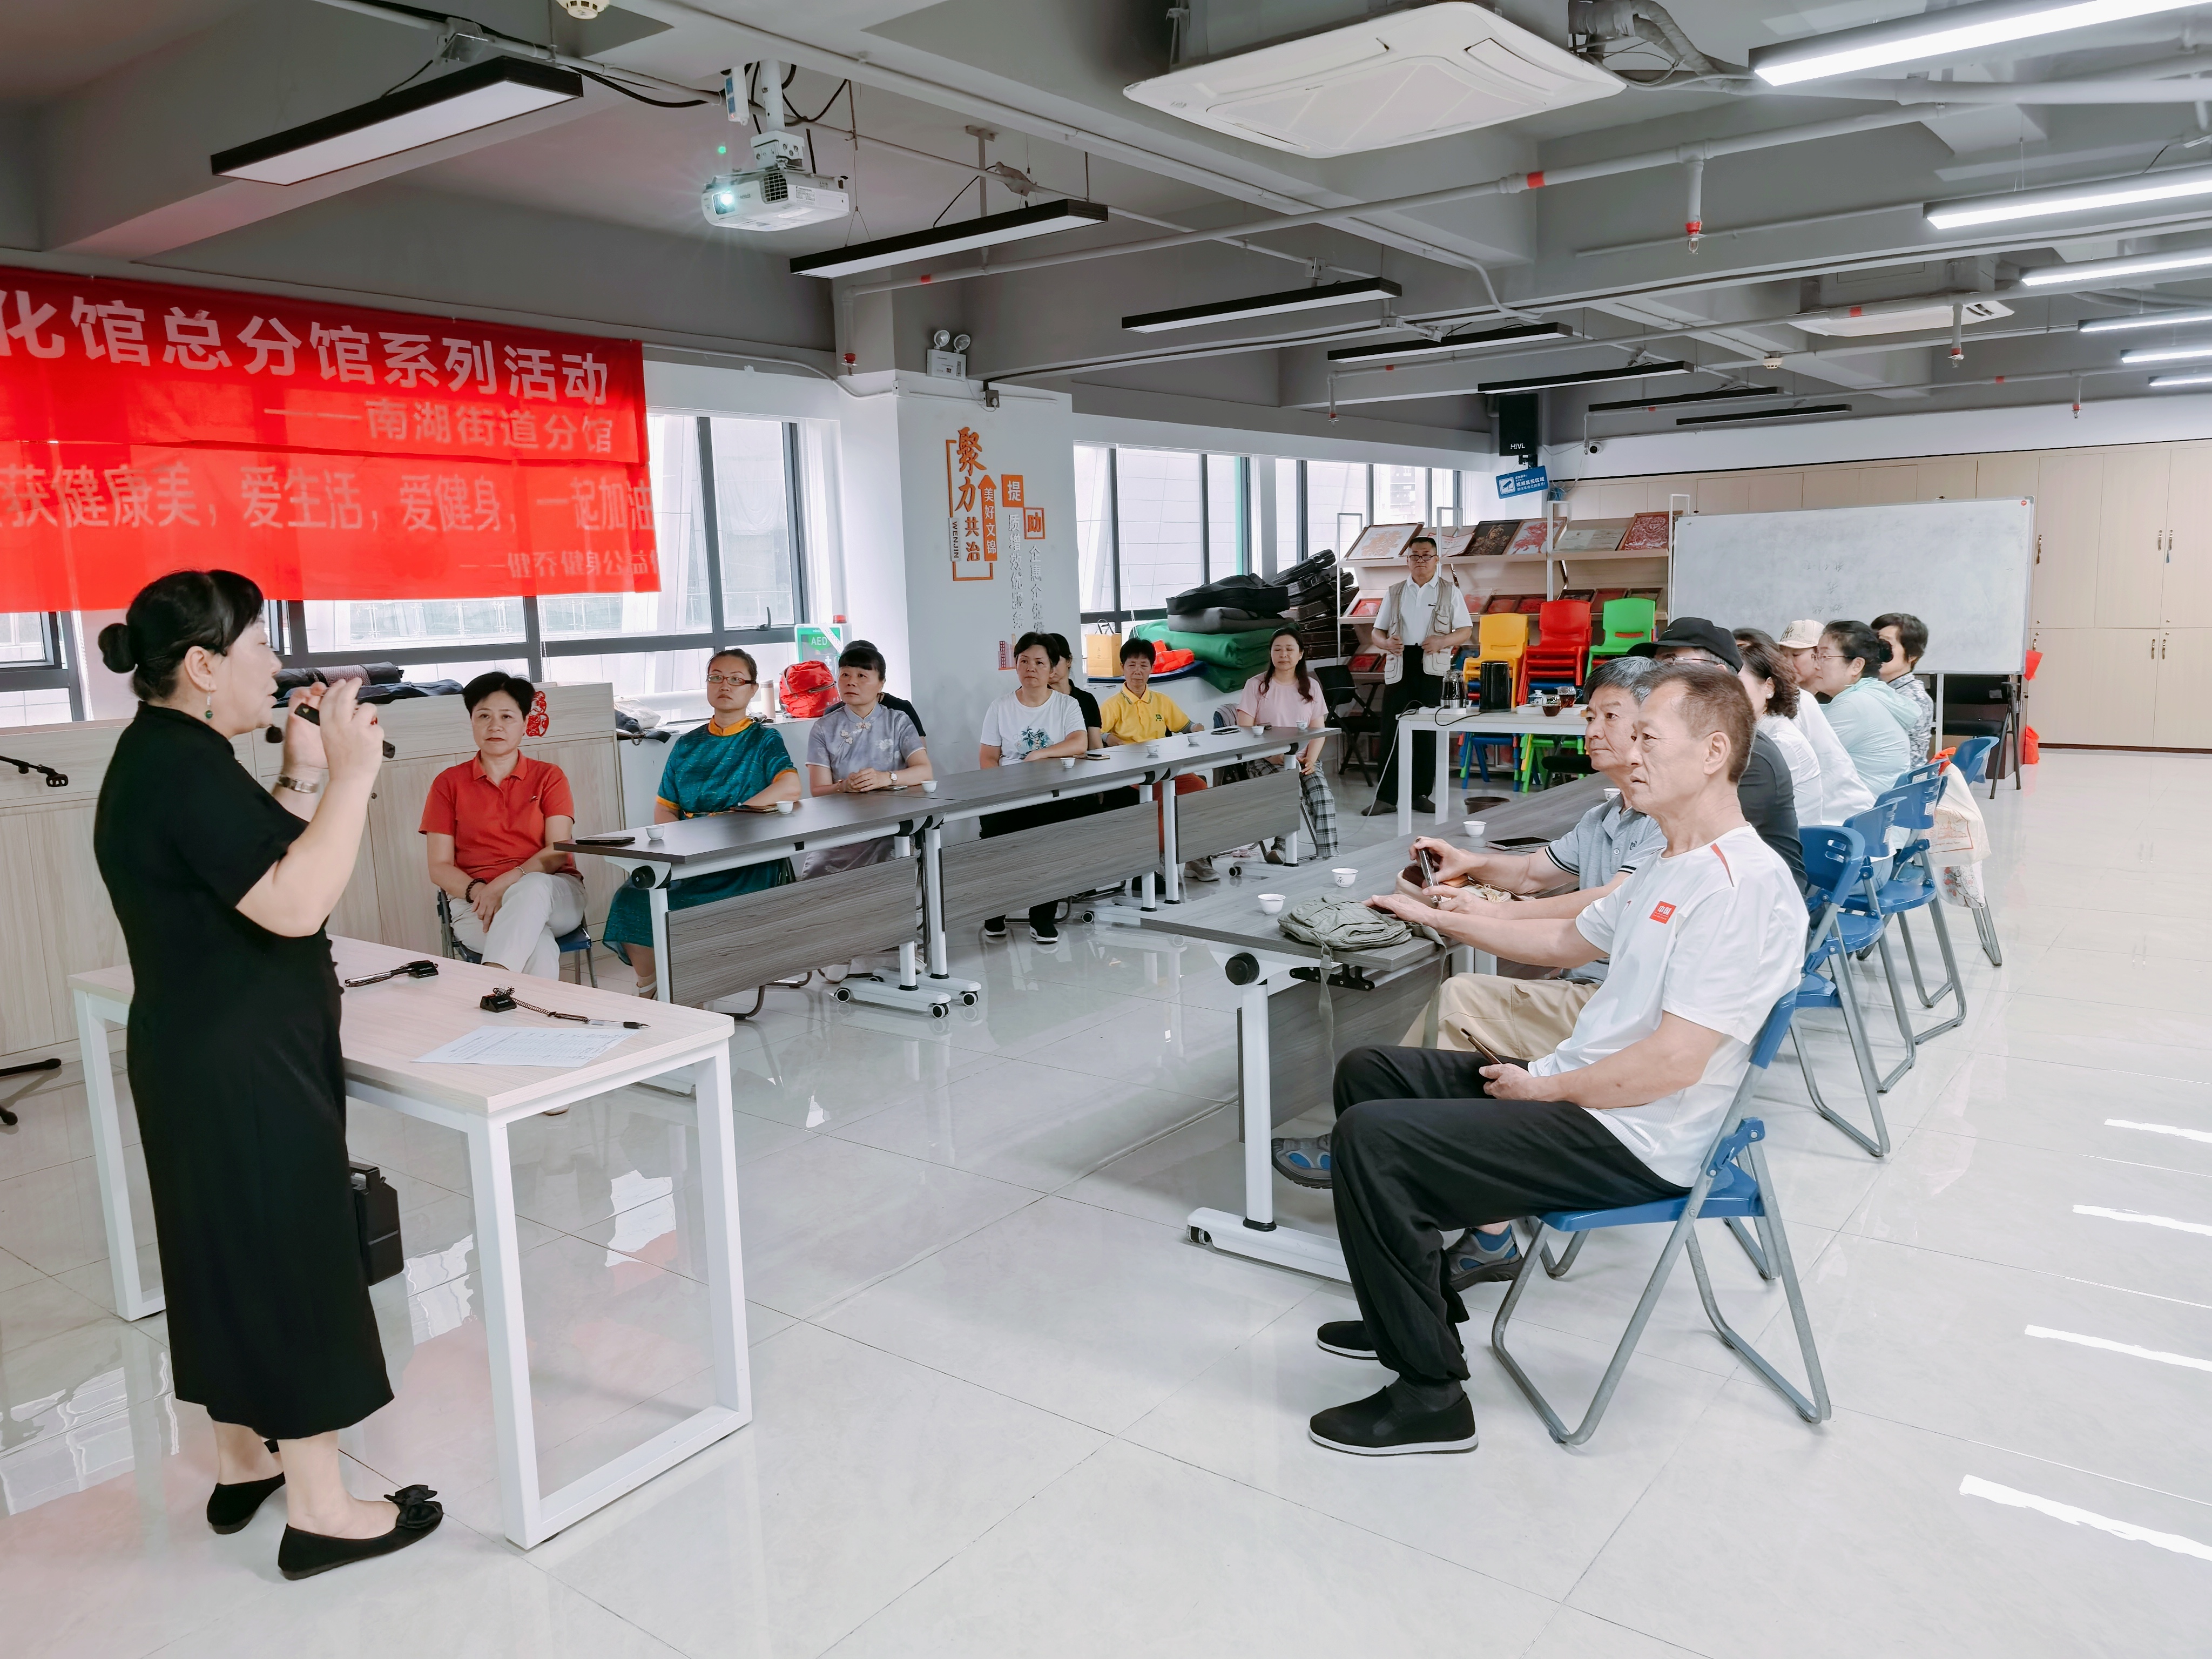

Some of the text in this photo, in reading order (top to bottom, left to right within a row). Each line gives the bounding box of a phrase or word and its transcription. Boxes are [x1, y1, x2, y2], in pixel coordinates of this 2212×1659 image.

[0, 289, 608, 404] 化馆总分馆系列活动
[984, 488, 997, 555] 美好文锦
[811, 637, 827, 645] AED
